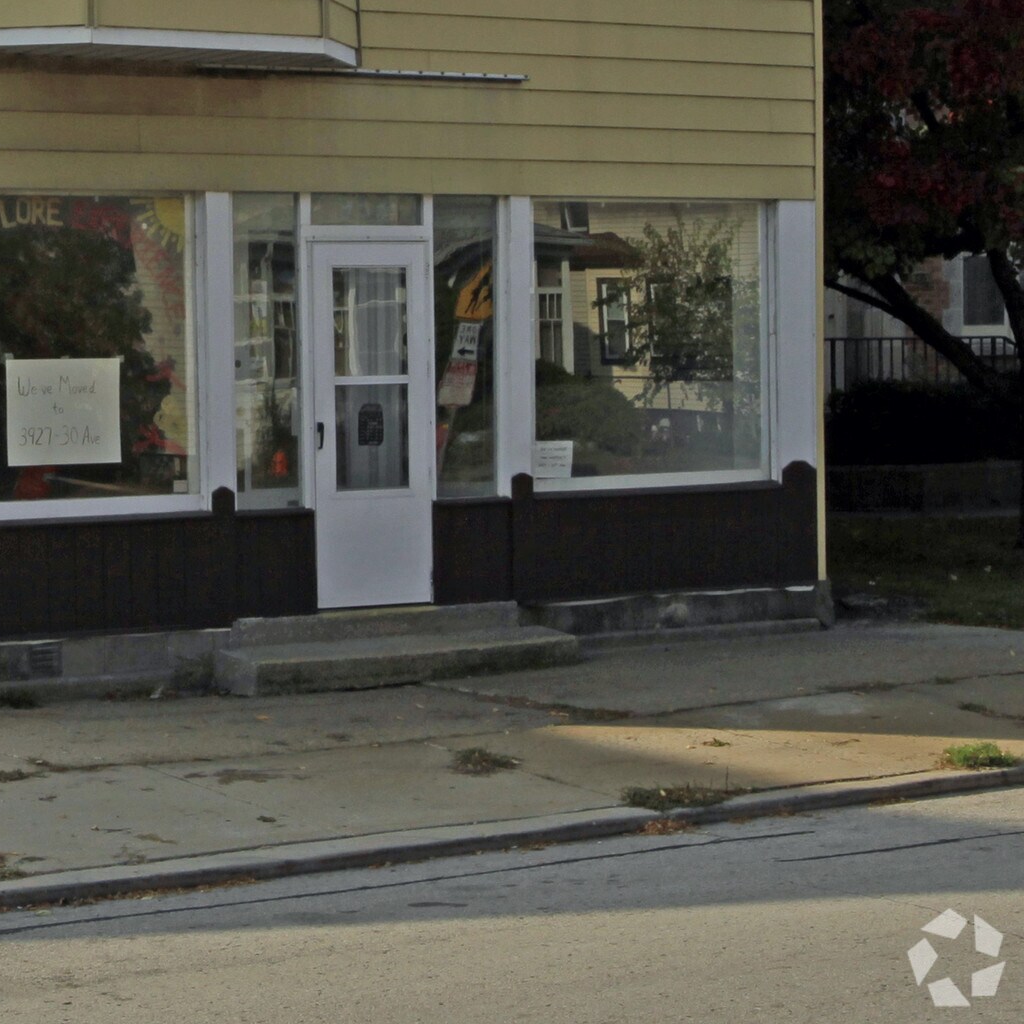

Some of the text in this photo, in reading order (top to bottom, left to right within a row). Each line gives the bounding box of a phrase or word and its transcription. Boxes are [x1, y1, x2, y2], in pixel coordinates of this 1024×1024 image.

[58, 375, 97, 396] Moved
[53, 402, 64, 415] to
[81, 424, 102, 446] Ave
